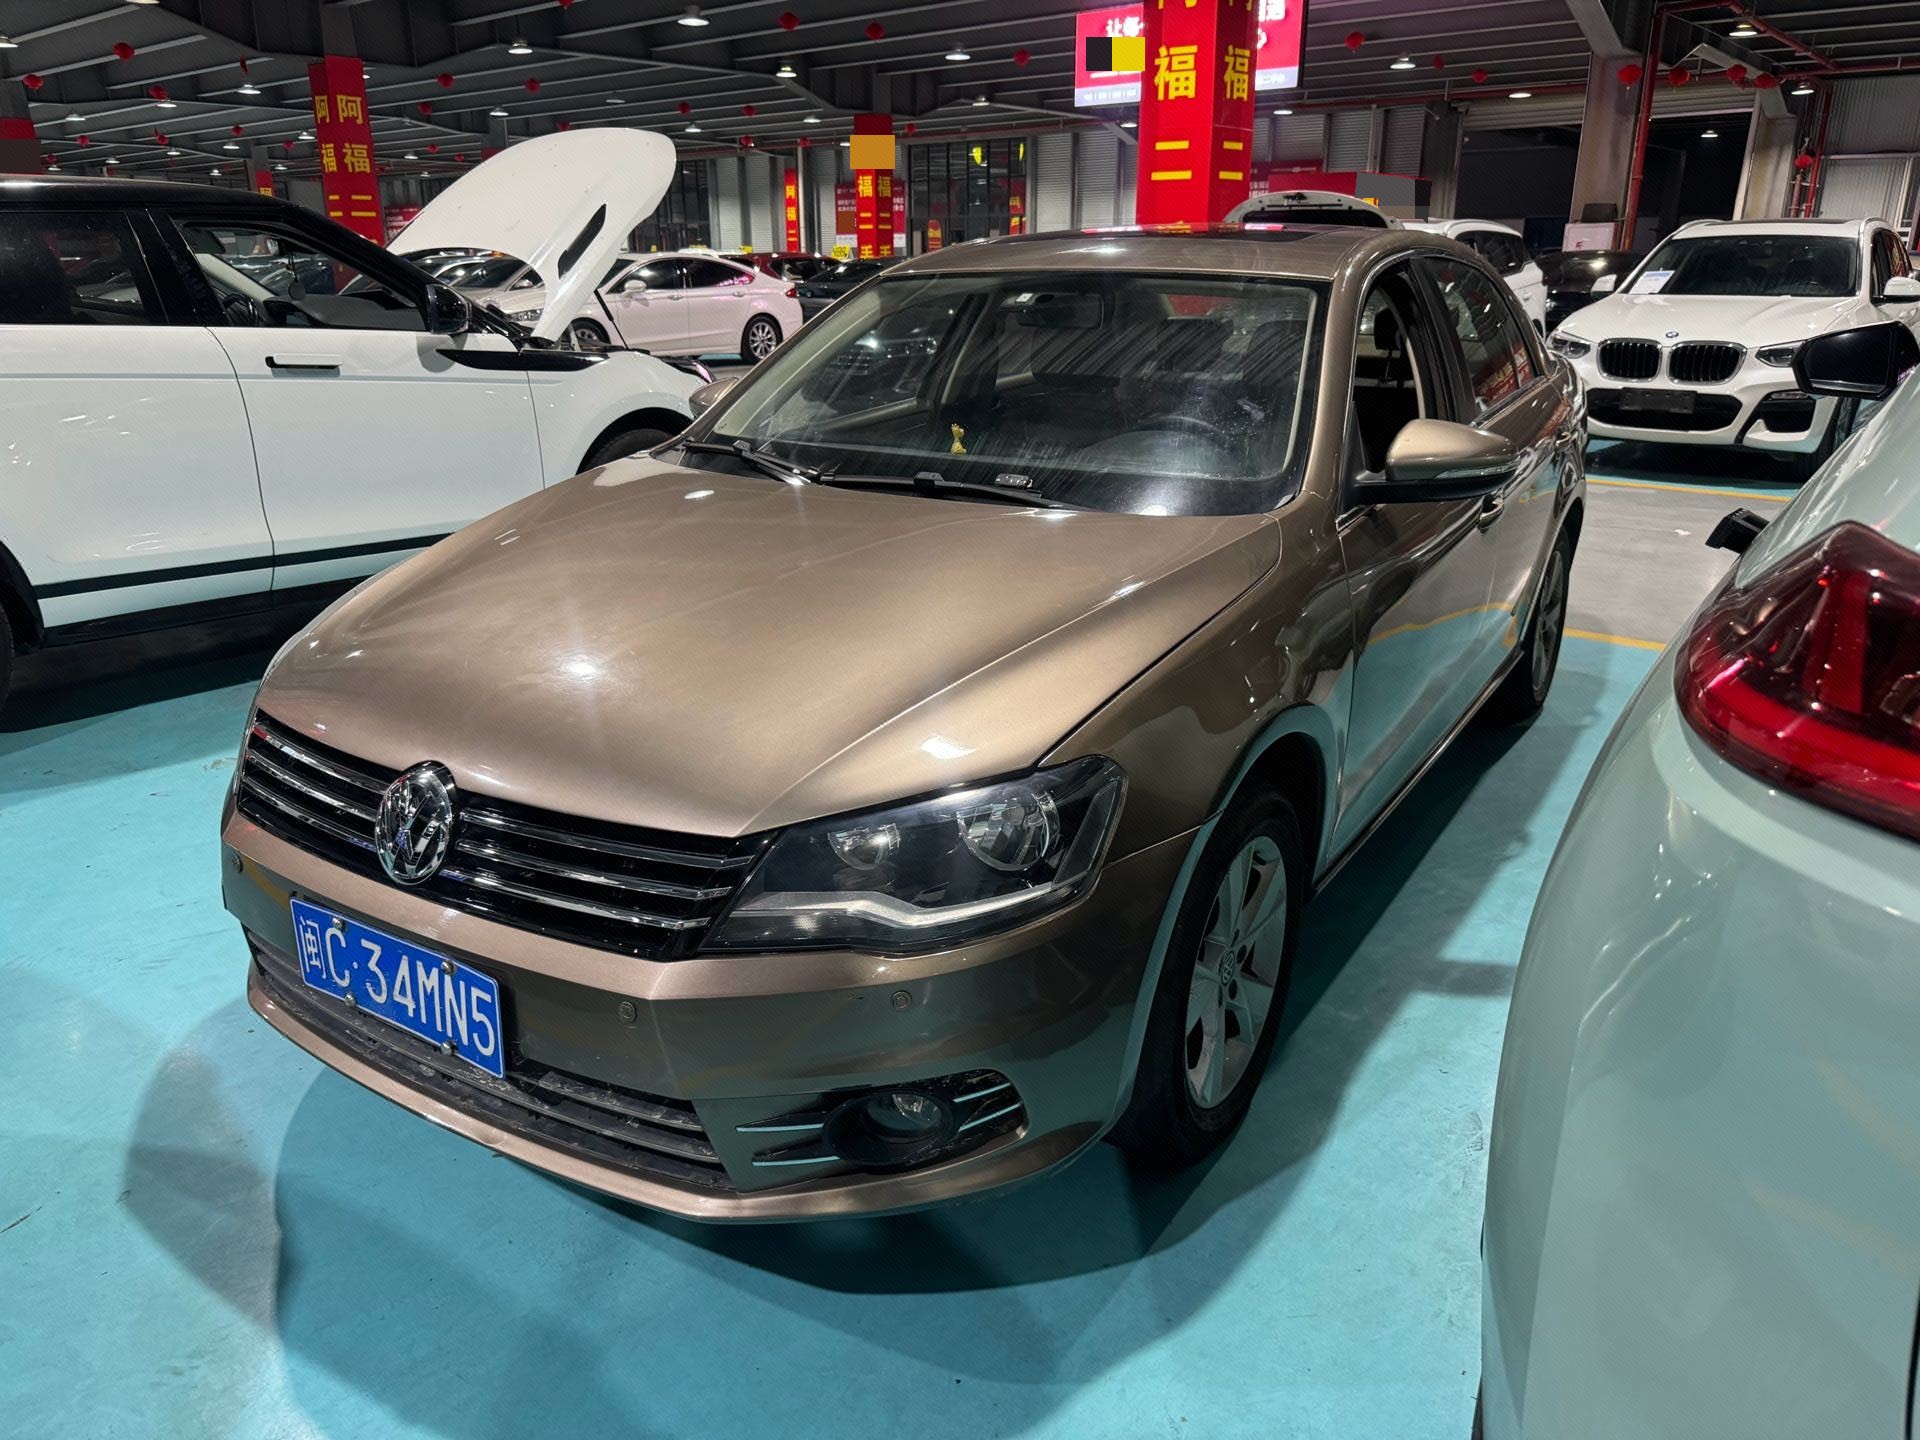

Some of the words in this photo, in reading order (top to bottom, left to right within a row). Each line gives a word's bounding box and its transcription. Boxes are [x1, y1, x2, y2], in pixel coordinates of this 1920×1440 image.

[315, 95, 343, 217] 阿福二
[336, 94, 377, 243] 阿福二
